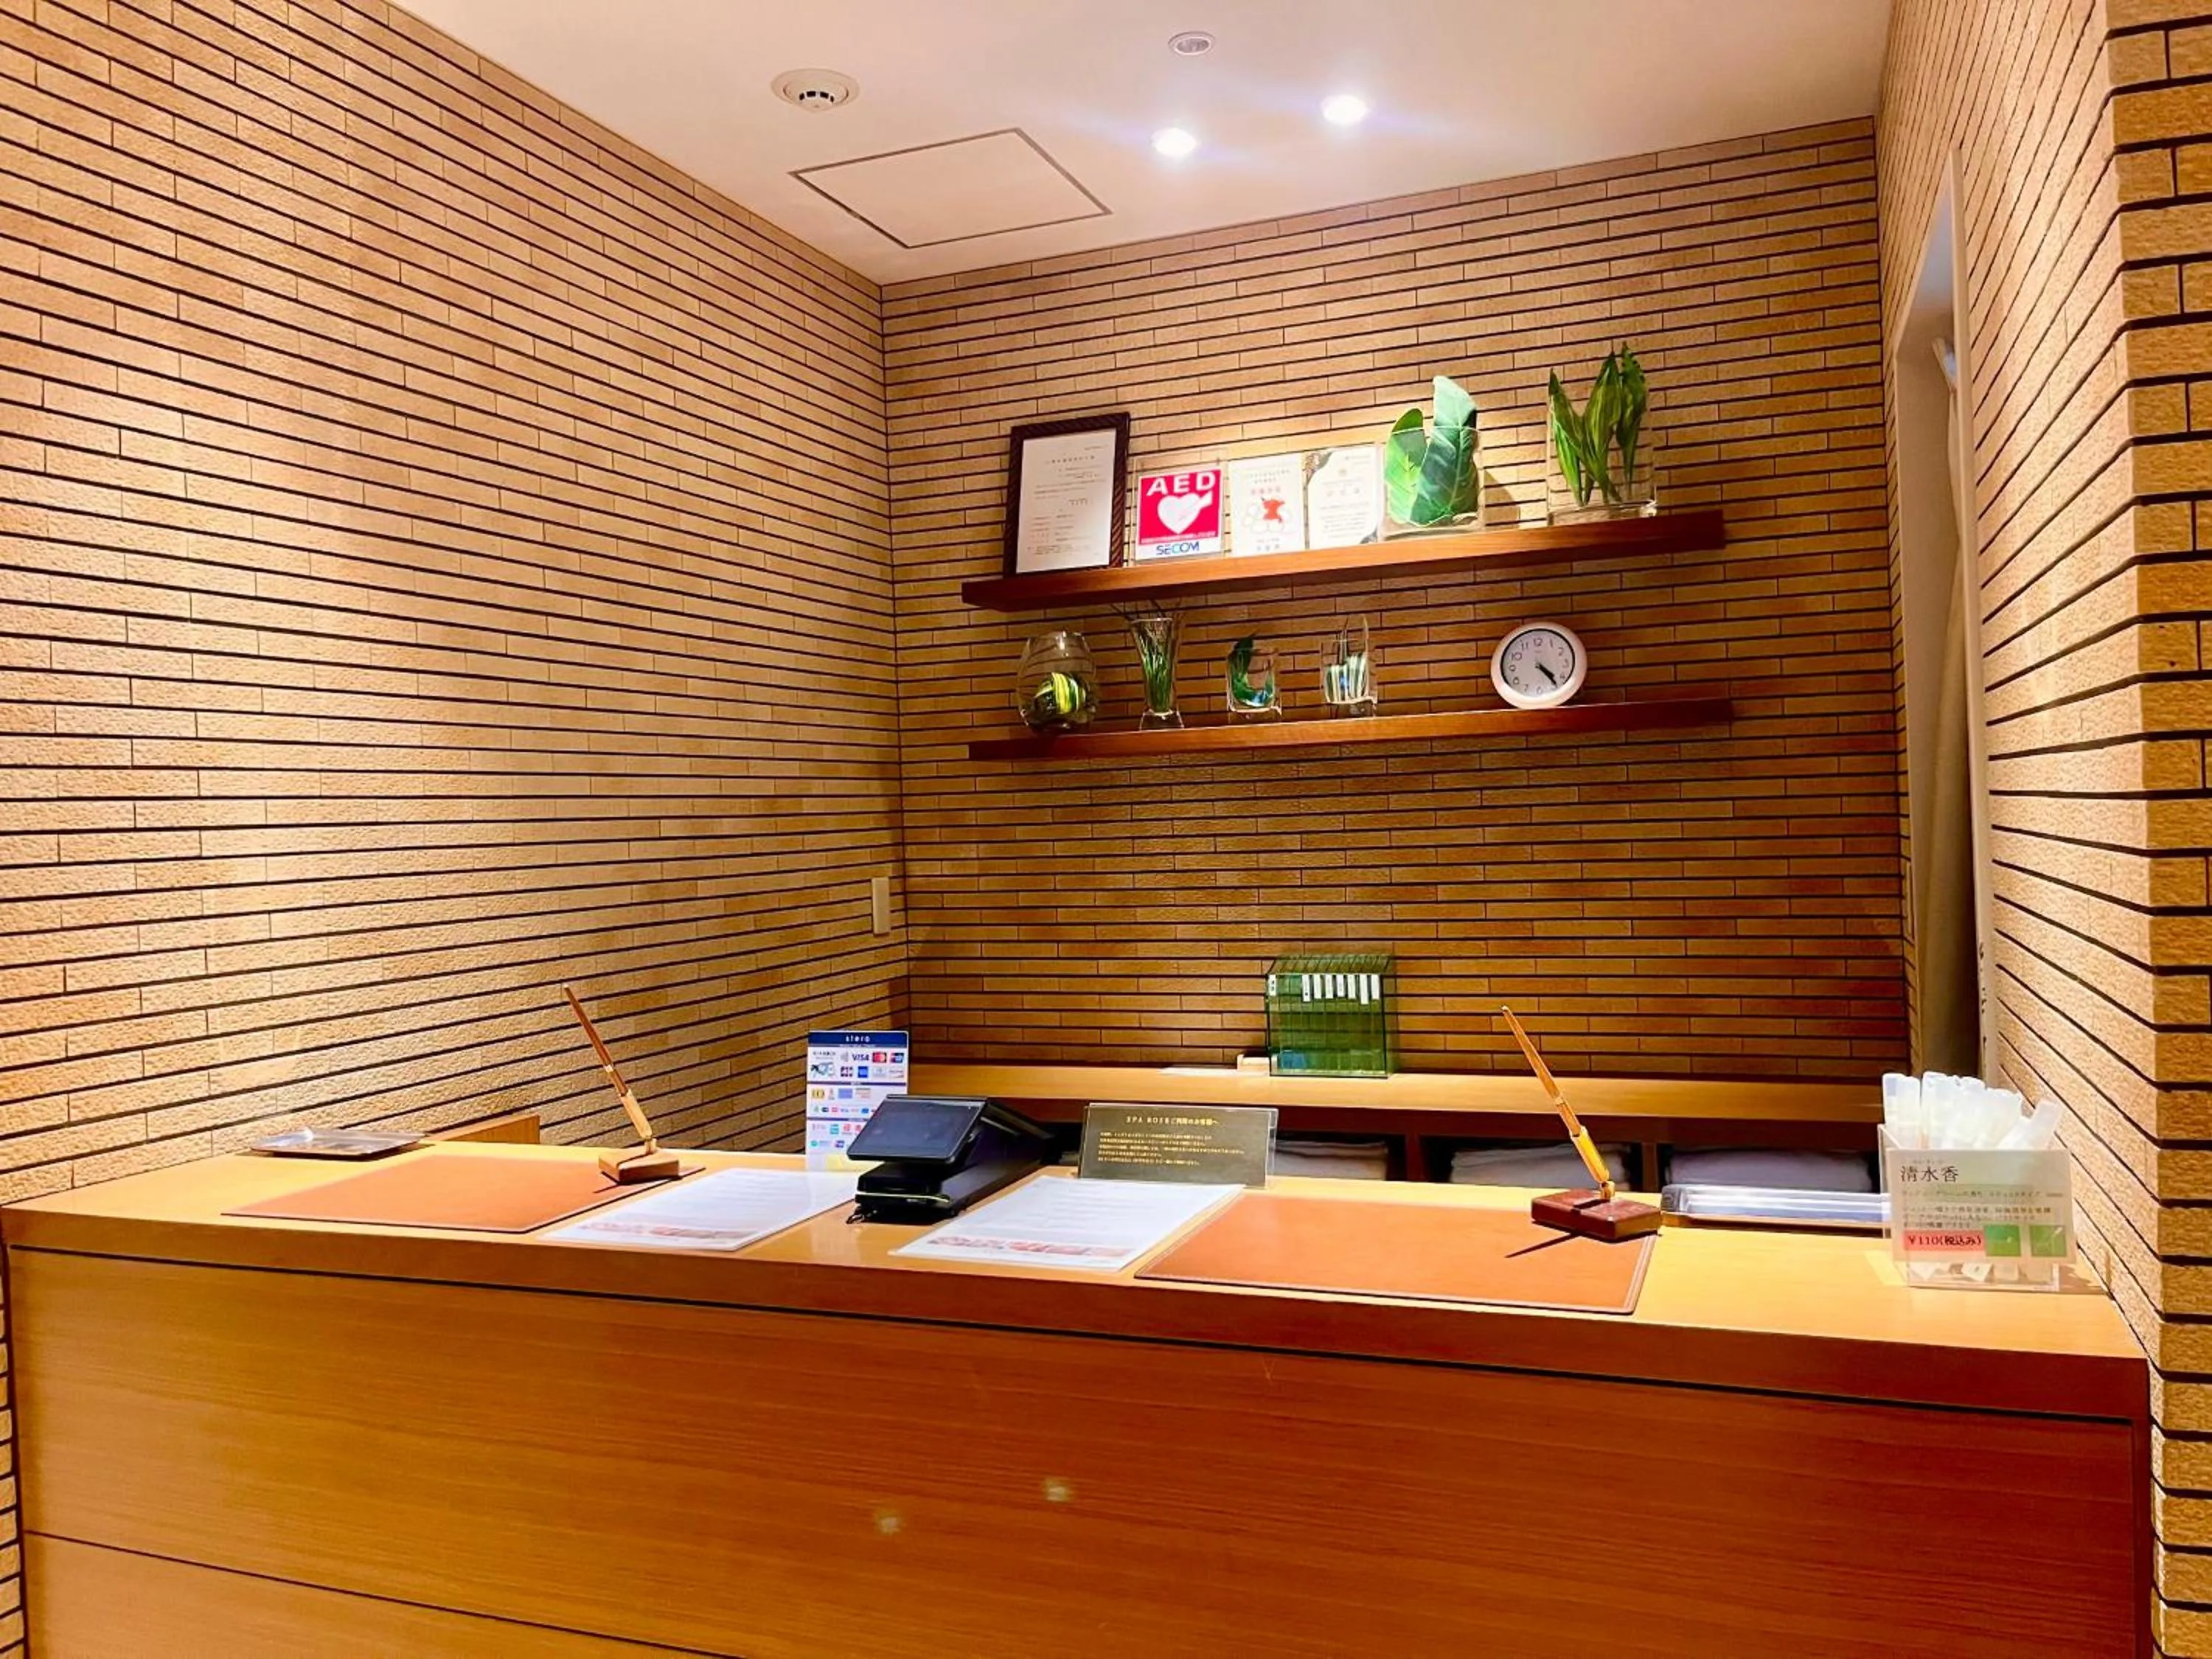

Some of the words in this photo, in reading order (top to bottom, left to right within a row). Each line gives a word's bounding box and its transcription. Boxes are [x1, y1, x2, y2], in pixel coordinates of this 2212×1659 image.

[1146, 472, 1216, 496] AED
[1156, 541, 1200, 556] SECOM
[1533, 638, 1543, 647] 12
[1512, 651, 1522, 661] 10
[1900, 1165, 1959, 1183] 清水香
